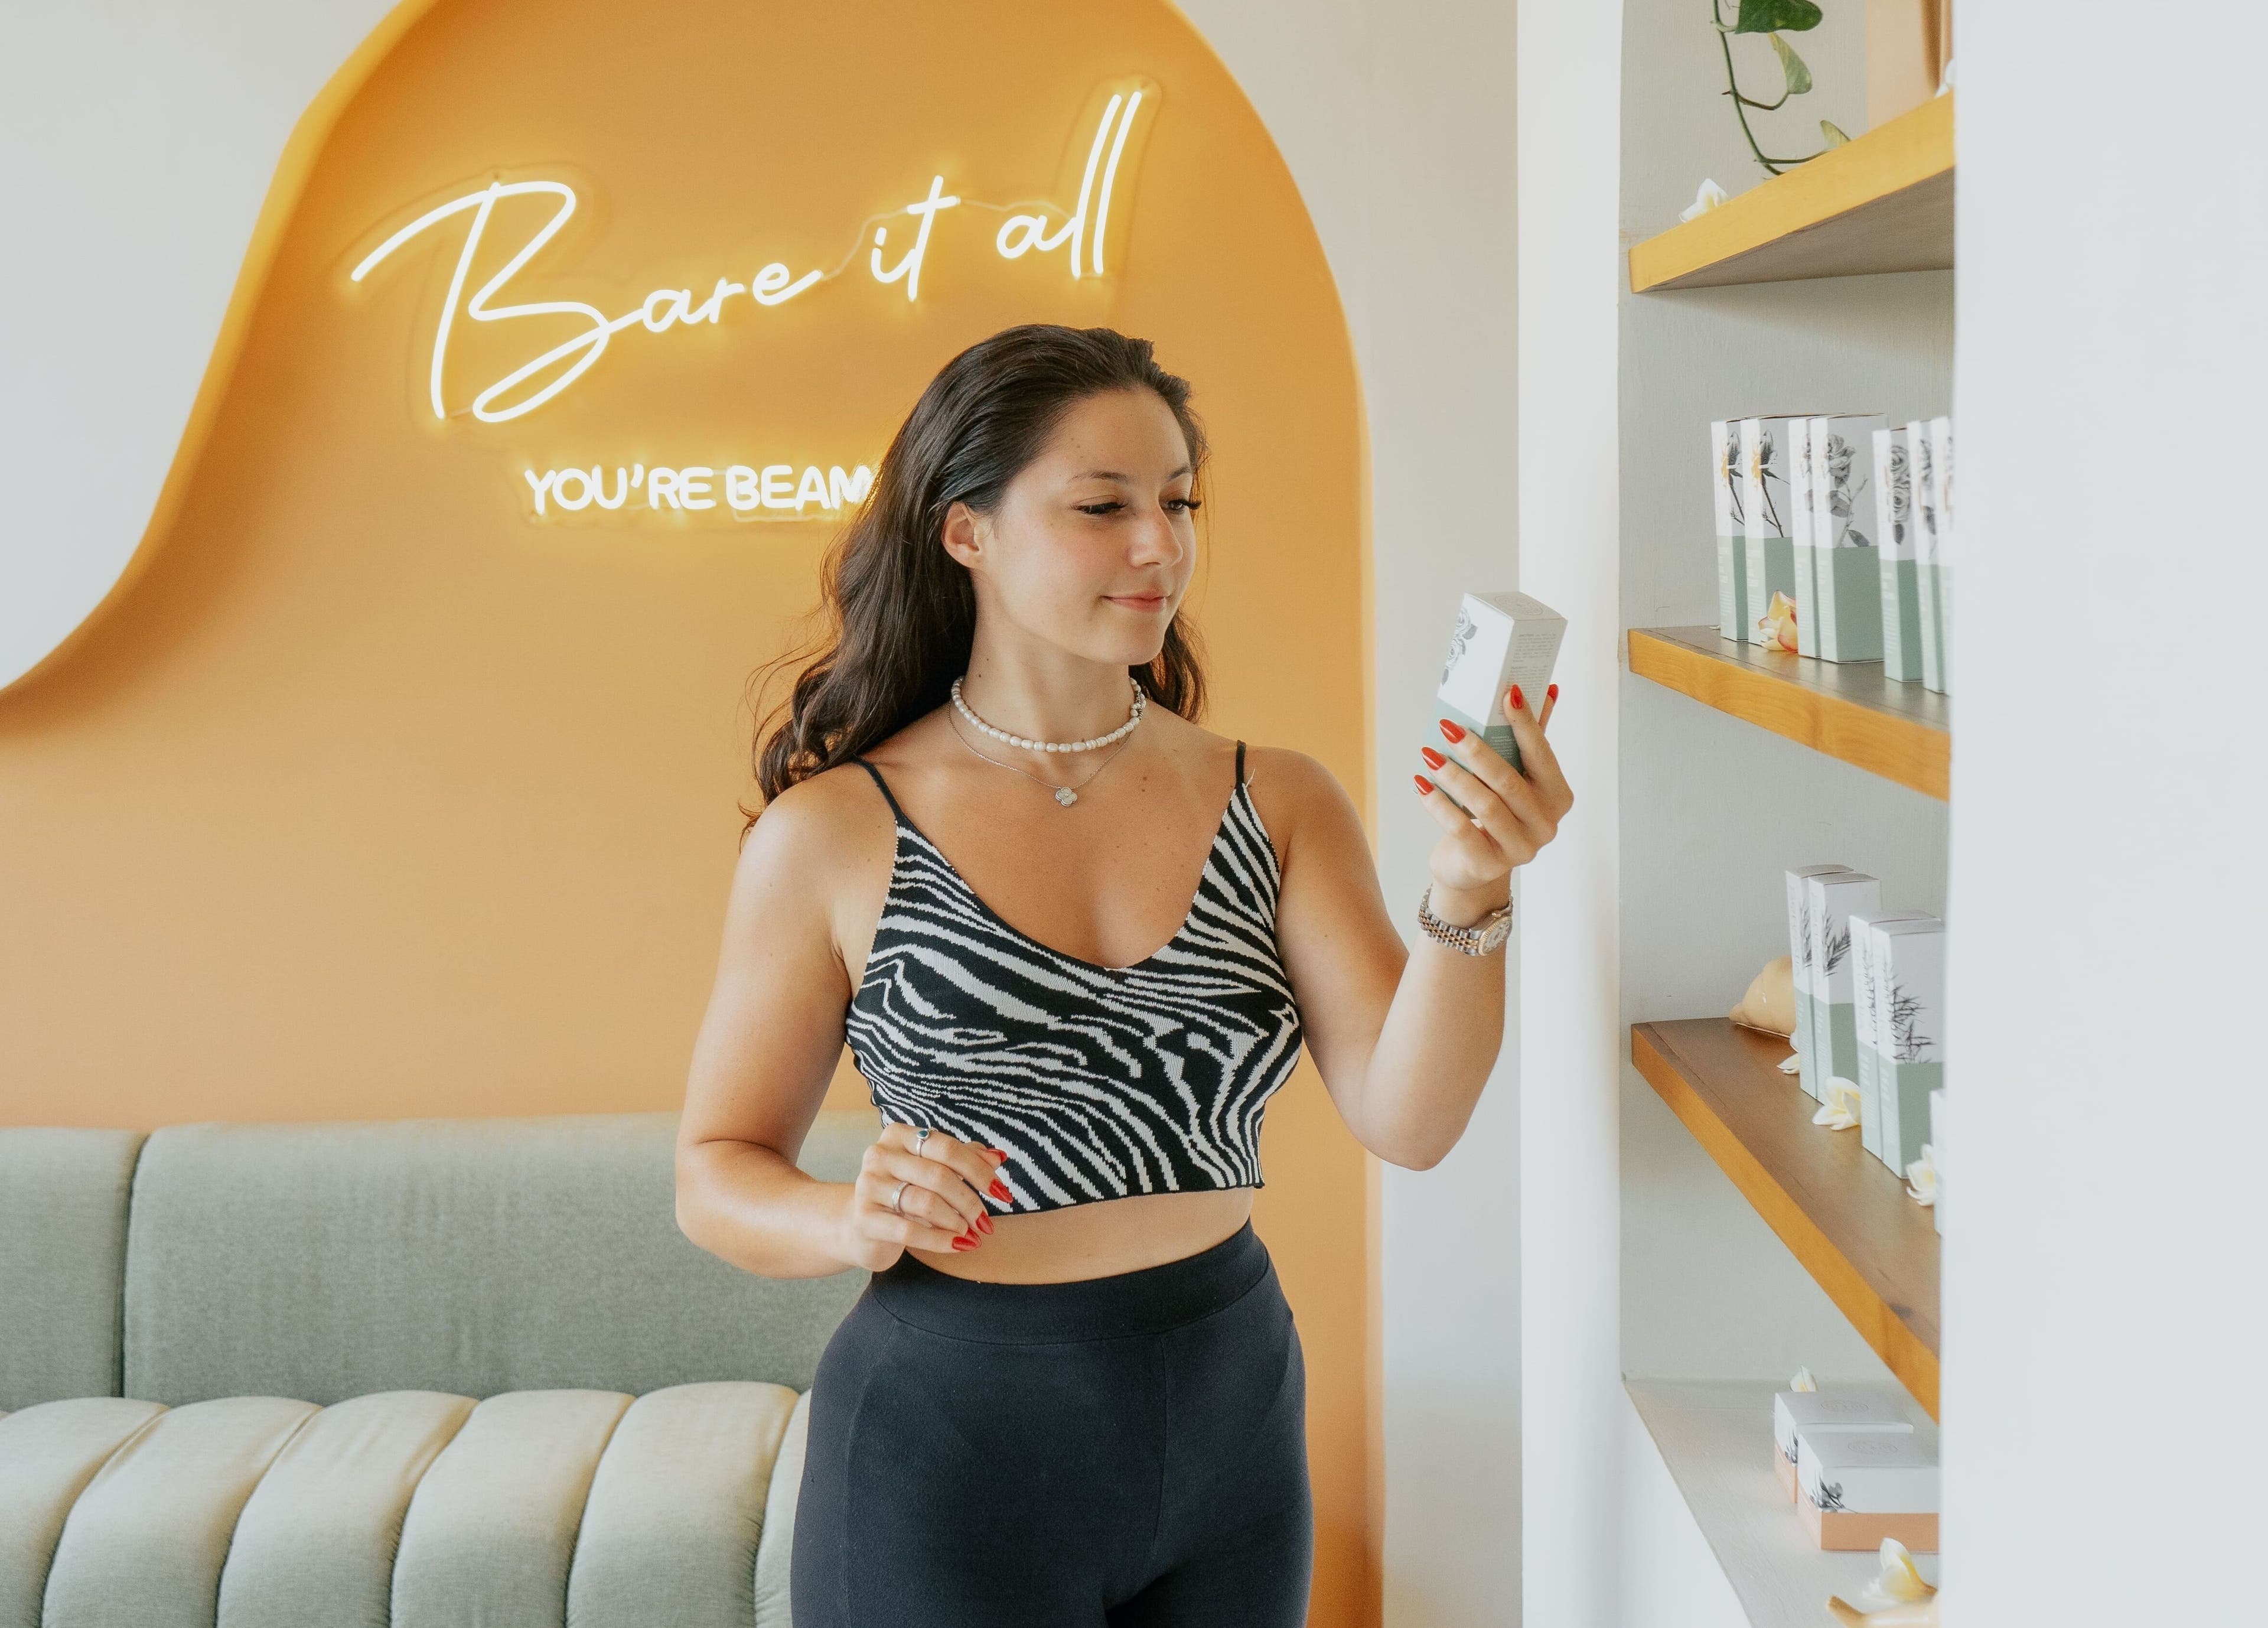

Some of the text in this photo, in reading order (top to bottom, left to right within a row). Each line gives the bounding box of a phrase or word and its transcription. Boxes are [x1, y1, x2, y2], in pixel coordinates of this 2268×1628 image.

[351, 91, 1142, 423] Bare it all
[524, 463, 716, 515] YOU'RE
